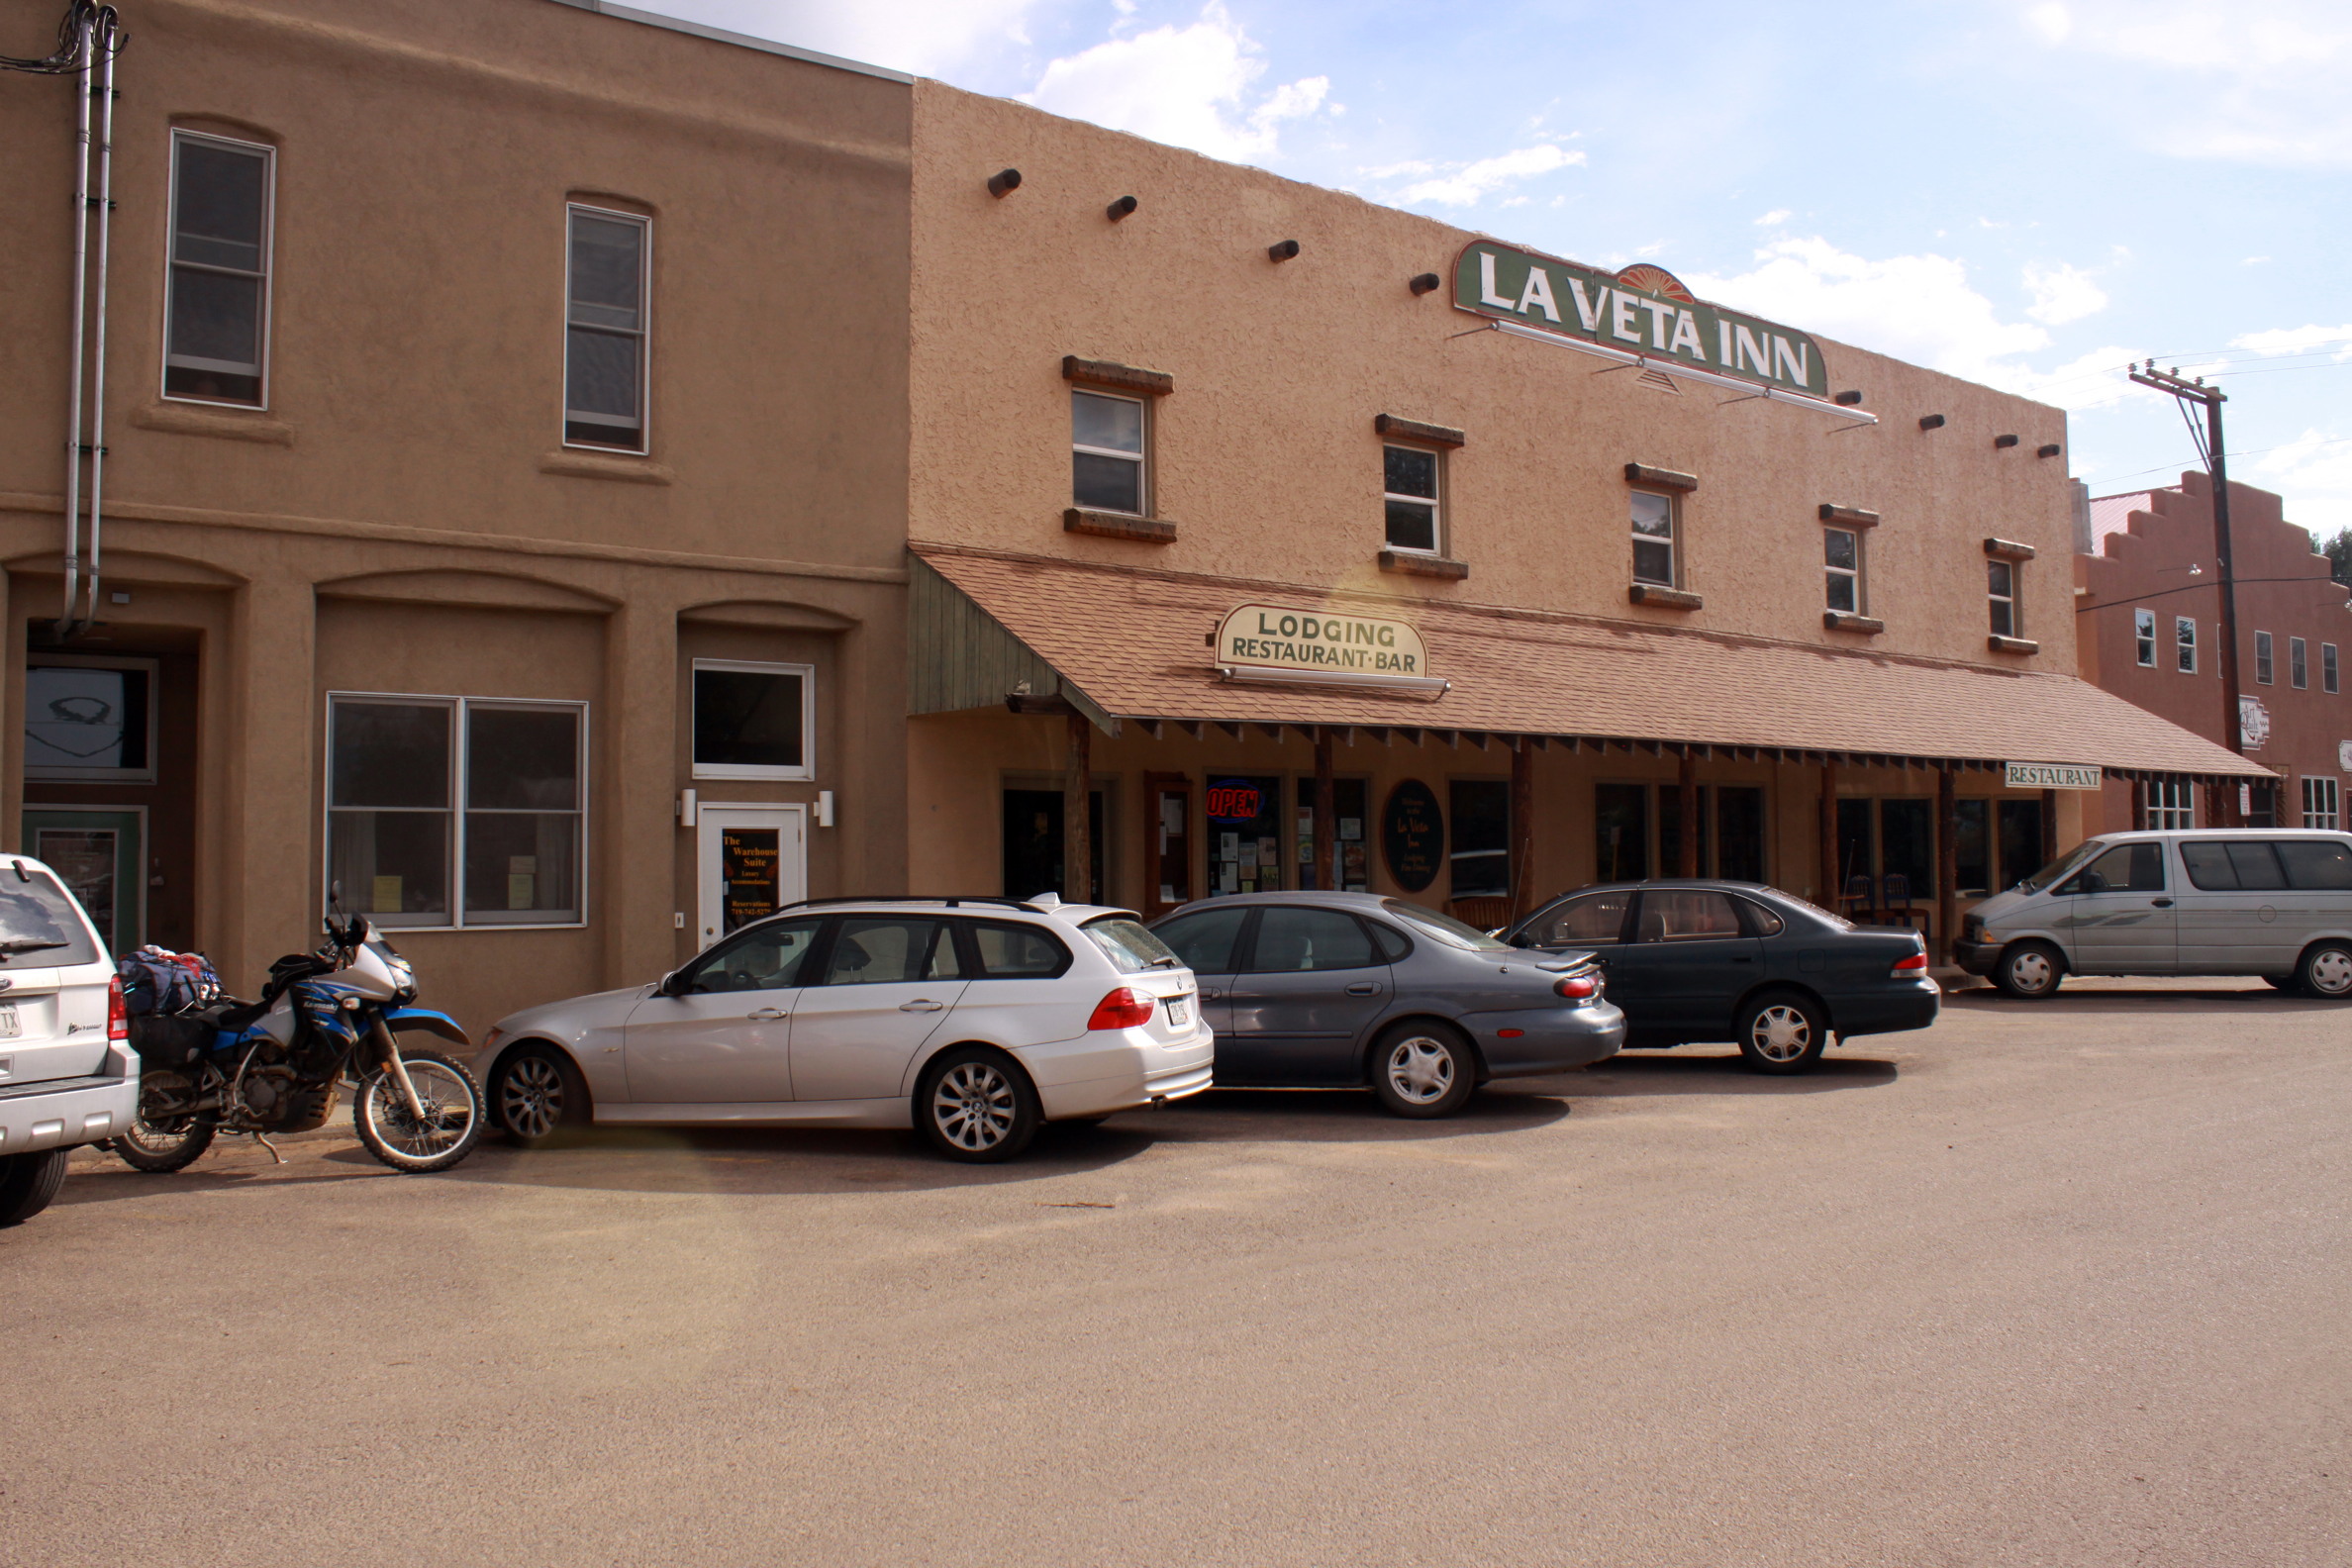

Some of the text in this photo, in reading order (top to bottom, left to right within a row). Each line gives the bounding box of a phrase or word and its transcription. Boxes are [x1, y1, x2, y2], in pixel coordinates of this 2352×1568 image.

[1479, 251, 1808, 387] LA VETA INN
[1258, 612, 1395, 647] LODGING
[2009, 766, 2099, 786] RESTAURANT
[1206, 788, 1259, 818] OPEN
[724, 835, 741, 845] The
[733, 847, 778, 856] Warehouse
[743, 857, 767, 867] Suite
